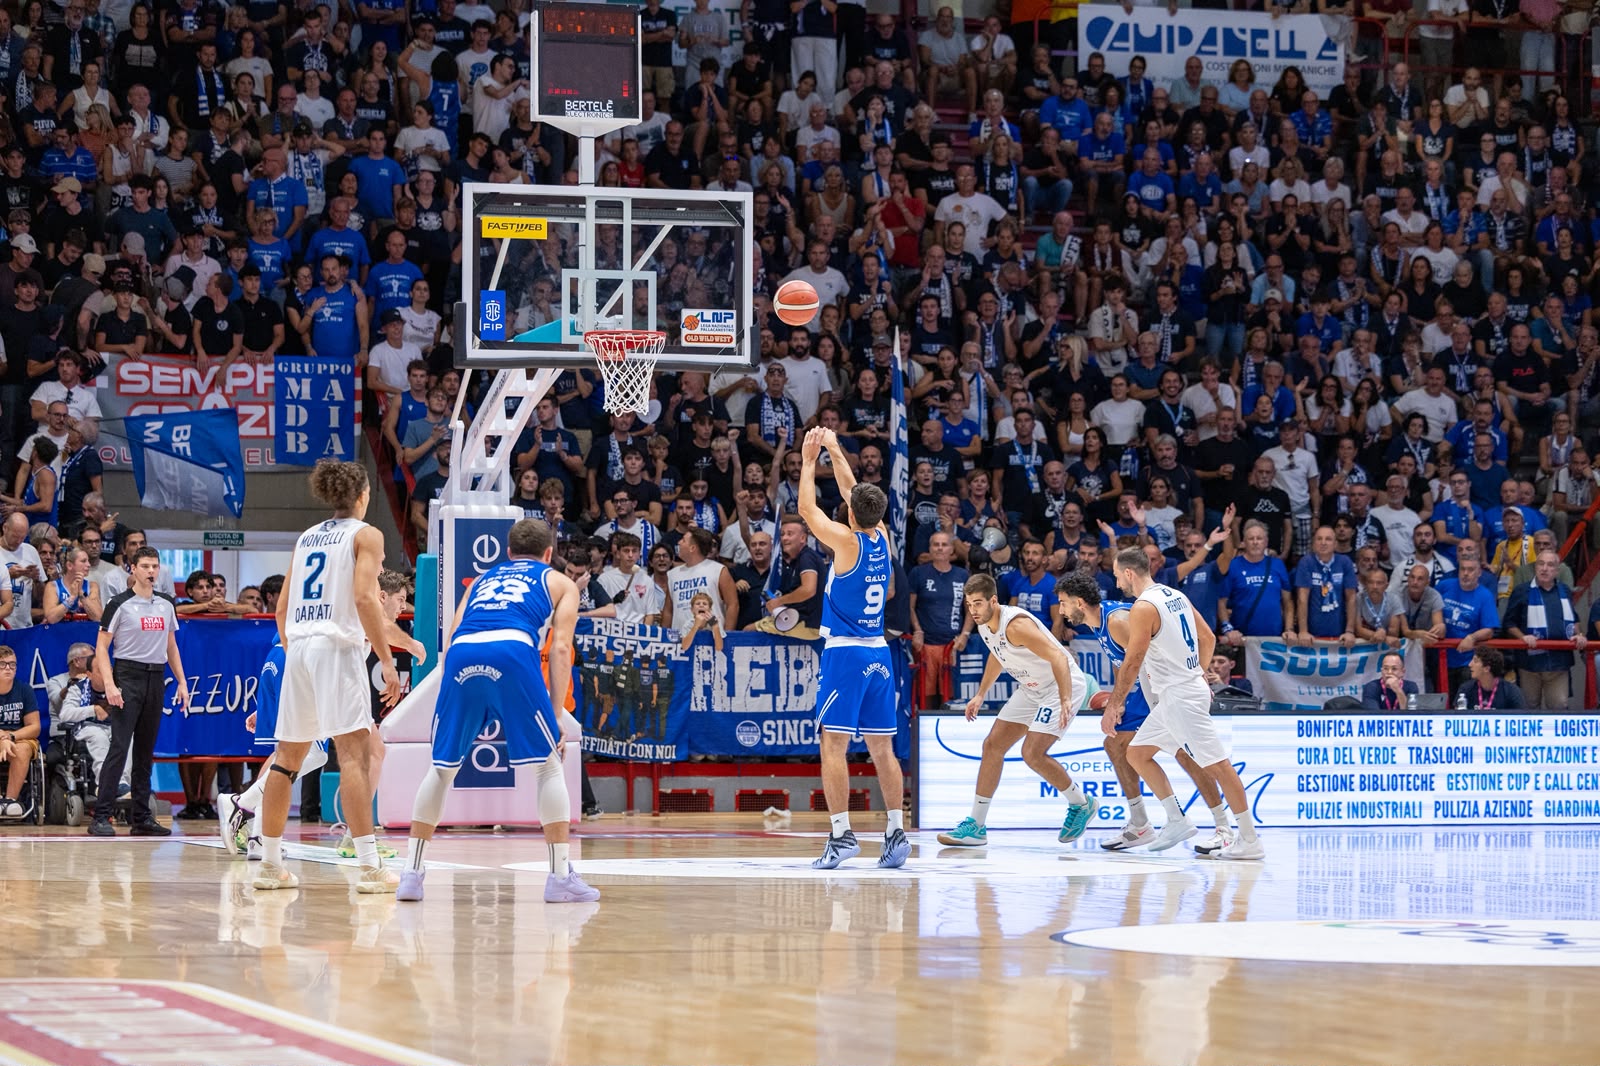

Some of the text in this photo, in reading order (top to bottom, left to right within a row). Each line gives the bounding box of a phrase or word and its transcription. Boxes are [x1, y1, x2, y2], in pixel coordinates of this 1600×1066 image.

[1086, 16, 1338, 61] CAMPANELLA
[487, 222, 542, 232] FASTWEB
[700, 311, 734, 323] LNP
[483, 323, 503, 331] FIP
[278, 362, 352, 376] GRUPPO
[303, 551, 327, 600] 2
[673, 576, 707, 591] CURVA
[469, 578, 531, 604] 33
[863, 584, 885, 615] 9
[592, 618, 662, 641] RIBELLI
[1179, 613, 1195, 653] 4
[612, 638, 689, 661] SEMPRE
[454, 664, 503, 685] LABROLENS
[1297, 685, 1358, 696] LIVORN
[1034, 706, 1053, 724] 13
[1297, 719, 1600, 738] BONIFICA AMBIENTALE PULIZIA E IGIENE LOGISTI
[628, 743, 654, 758] CON
[656, 744, 677, 759] NOI
[1297, 746, 1598, 765] CURA DEL VERDE TRASLOCHI DISINFESTAZIONE E
[1297, 774, 1355, 792] GESTIONE
[1359, 774, 1435, 792] BIBLIOTECHE
[1447, 773, 1503, 791] GESTIONE
[1507, 773, 1530, 791] CUP
[1534, 773, 1541, 791] E
[1544, 773, 1573, 791] CALL
[1297, 801, 1343, 819] PULIZIE
[1347, 801, 1422, 819] INDUSTRIALI
[1434, 801, 1480, 818] PULIZIA
[1483, 800, 1533, 818] AZIENDE
